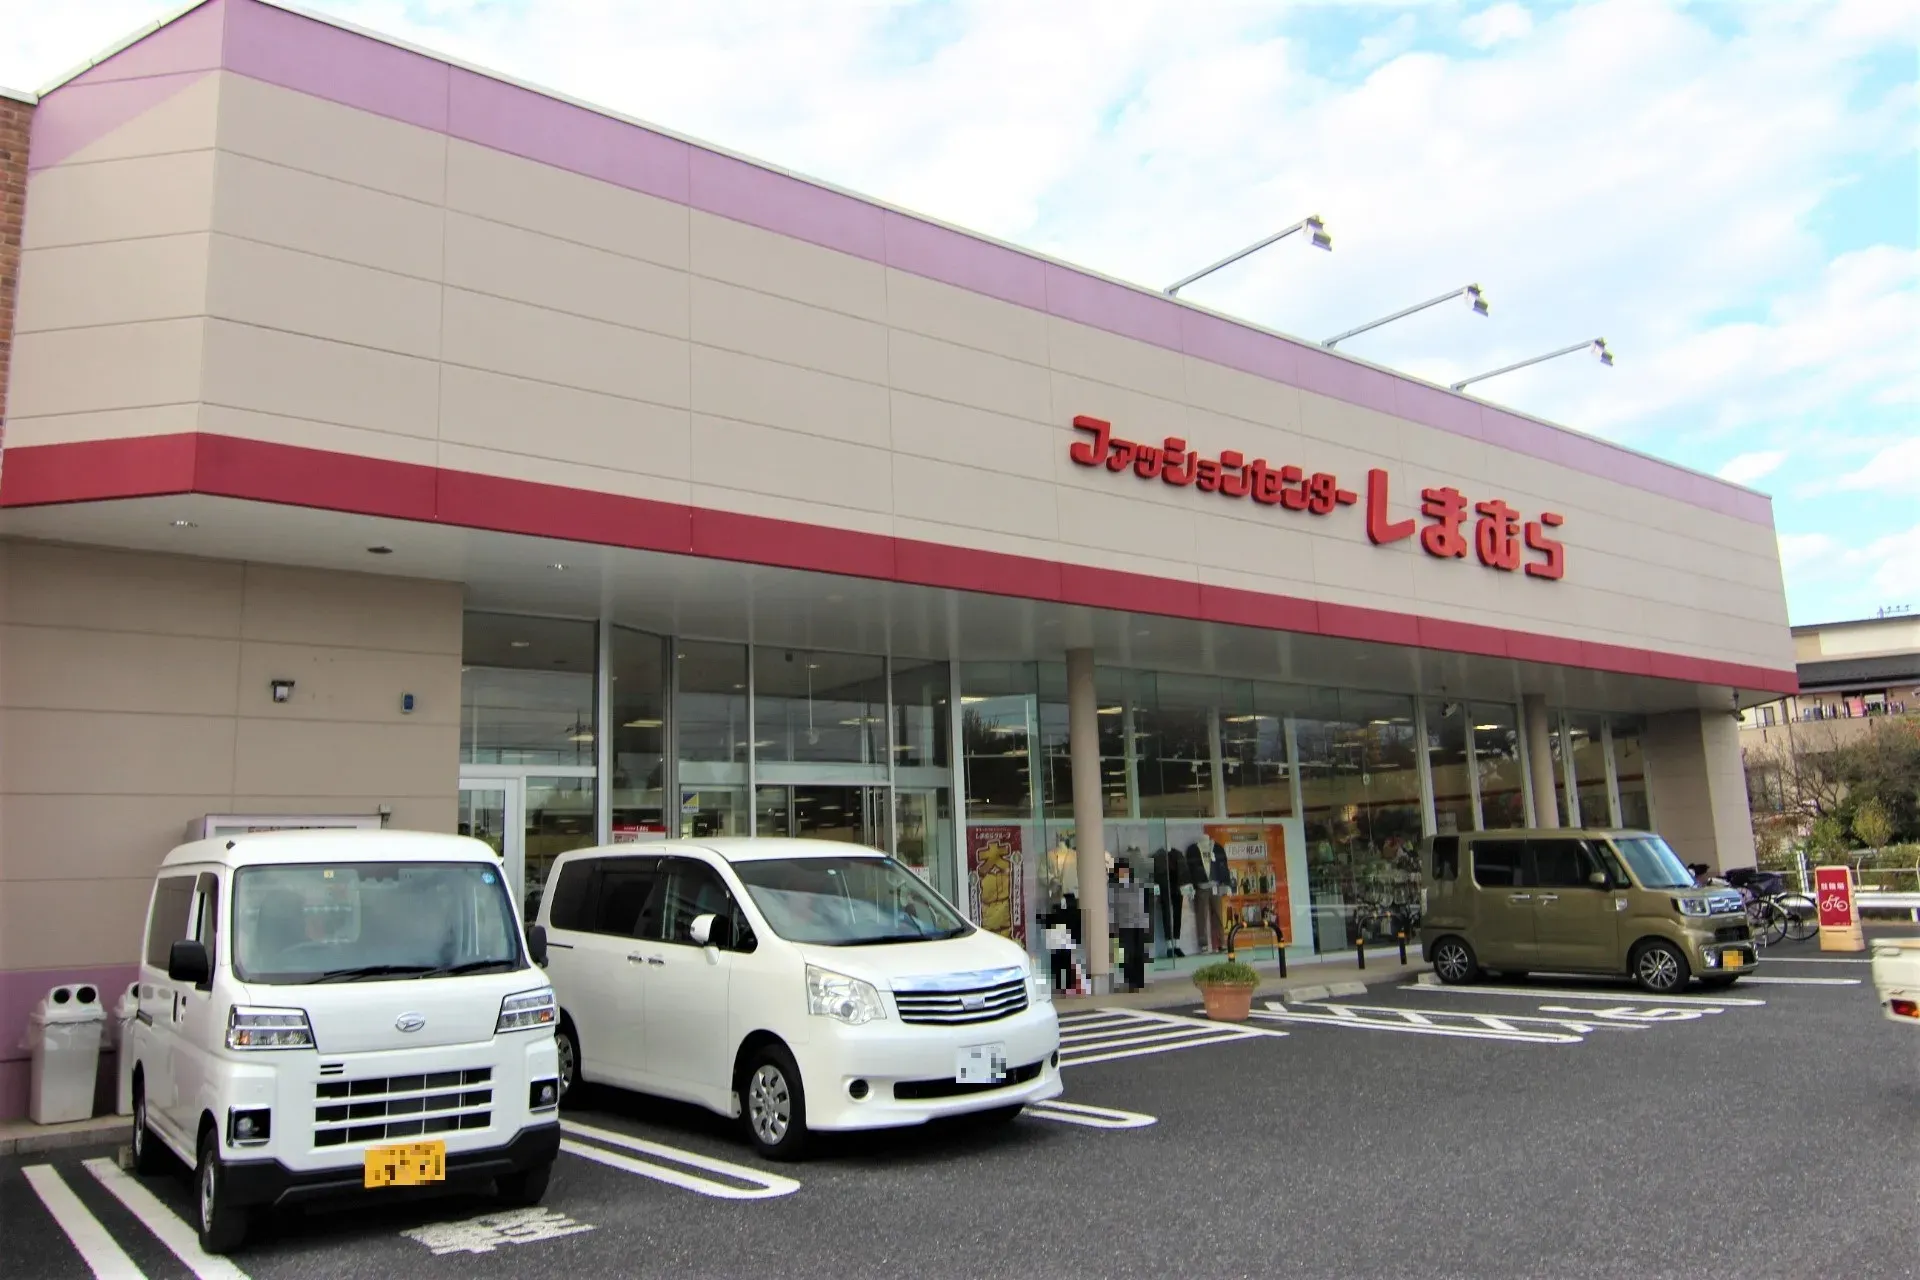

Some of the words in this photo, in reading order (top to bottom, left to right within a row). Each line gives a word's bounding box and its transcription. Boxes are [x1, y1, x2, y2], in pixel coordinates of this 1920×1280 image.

[1070, 414, 1357, 515] ファッションセンター
[1367, 468, 1564, 580] しまむら
